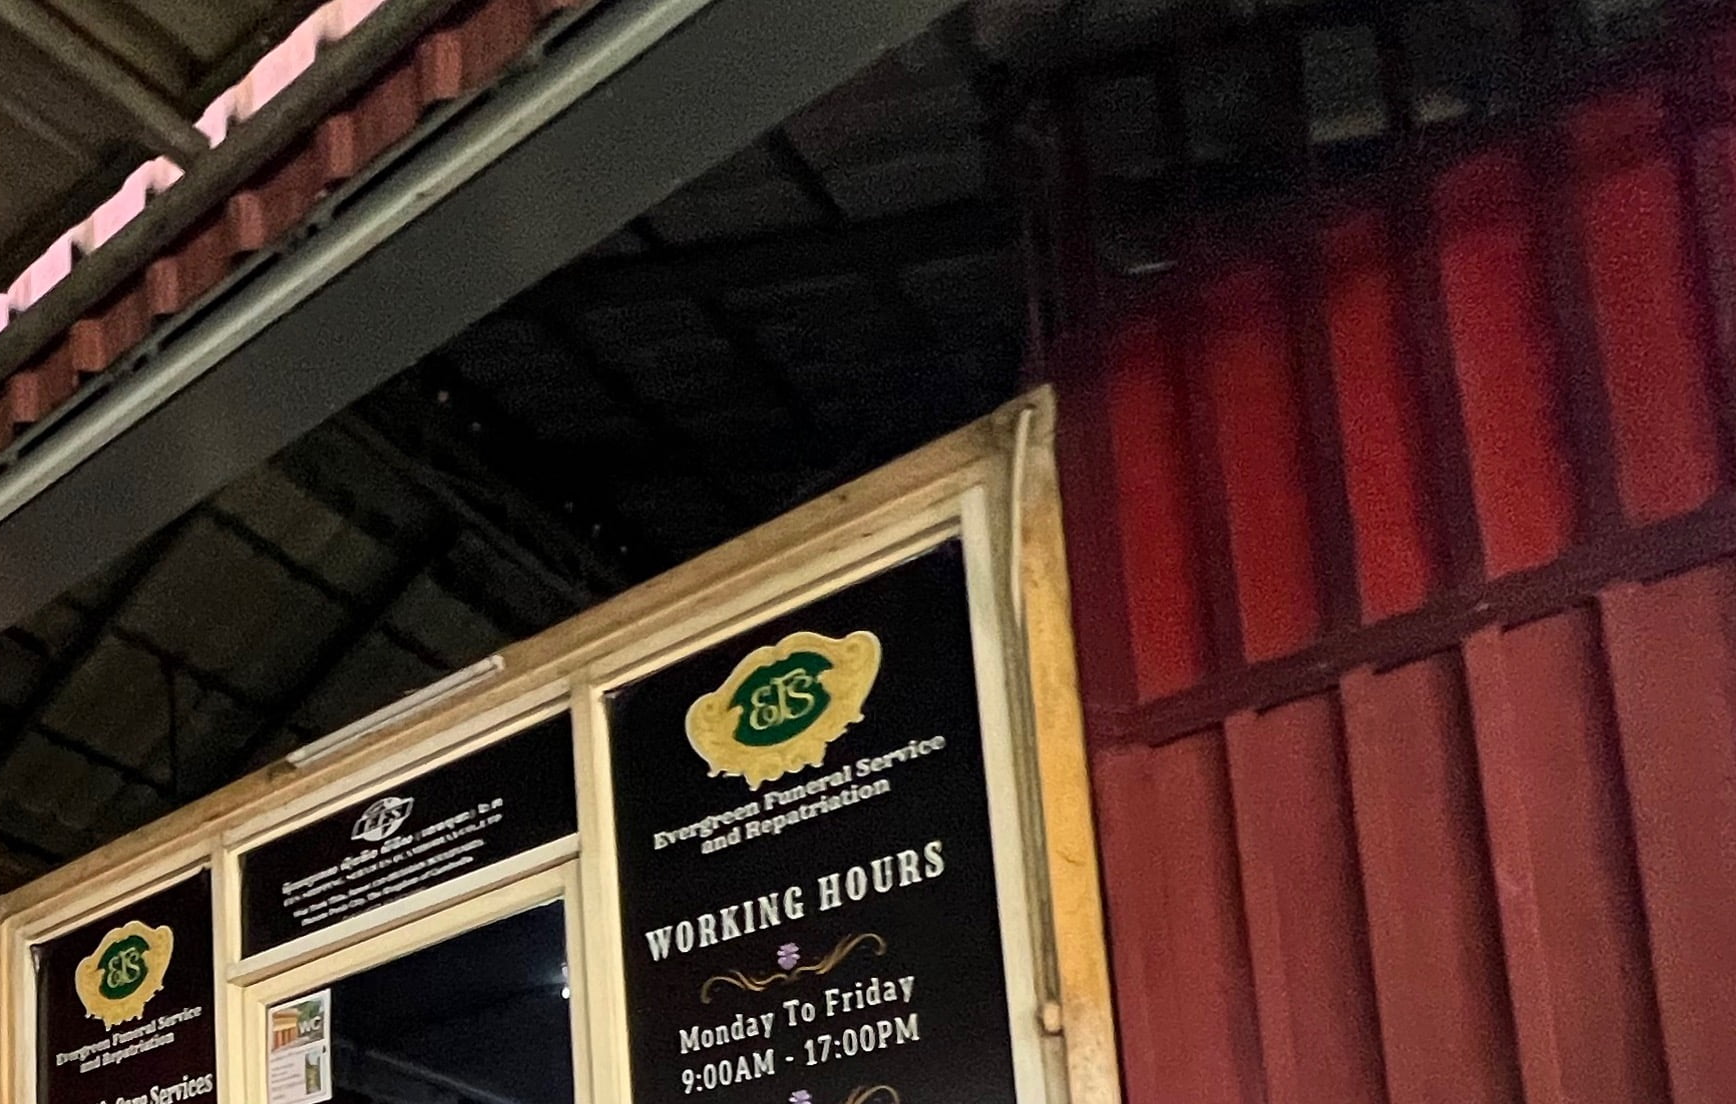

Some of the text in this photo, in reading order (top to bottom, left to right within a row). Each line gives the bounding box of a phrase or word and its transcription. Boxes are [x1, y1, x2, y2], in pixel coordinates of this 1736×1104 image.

[654, 736, 946, 850] Evergreen Funeral Service
[701, 779, 892, 854] and Repatriation
[645, 840, 945, 962] WORKING HOURS
[56, 1006, 202, 1066] Evergreen Funeral Service
[298, 1016, 322, 1035] WC
[679, 976, 915, 1054] Monday To Friday
[80, 1056, 101, 1073] and
[681, 1049, 775, 1094] 9:00AM
[804, 1014, 920, 1066] 17:00PM
